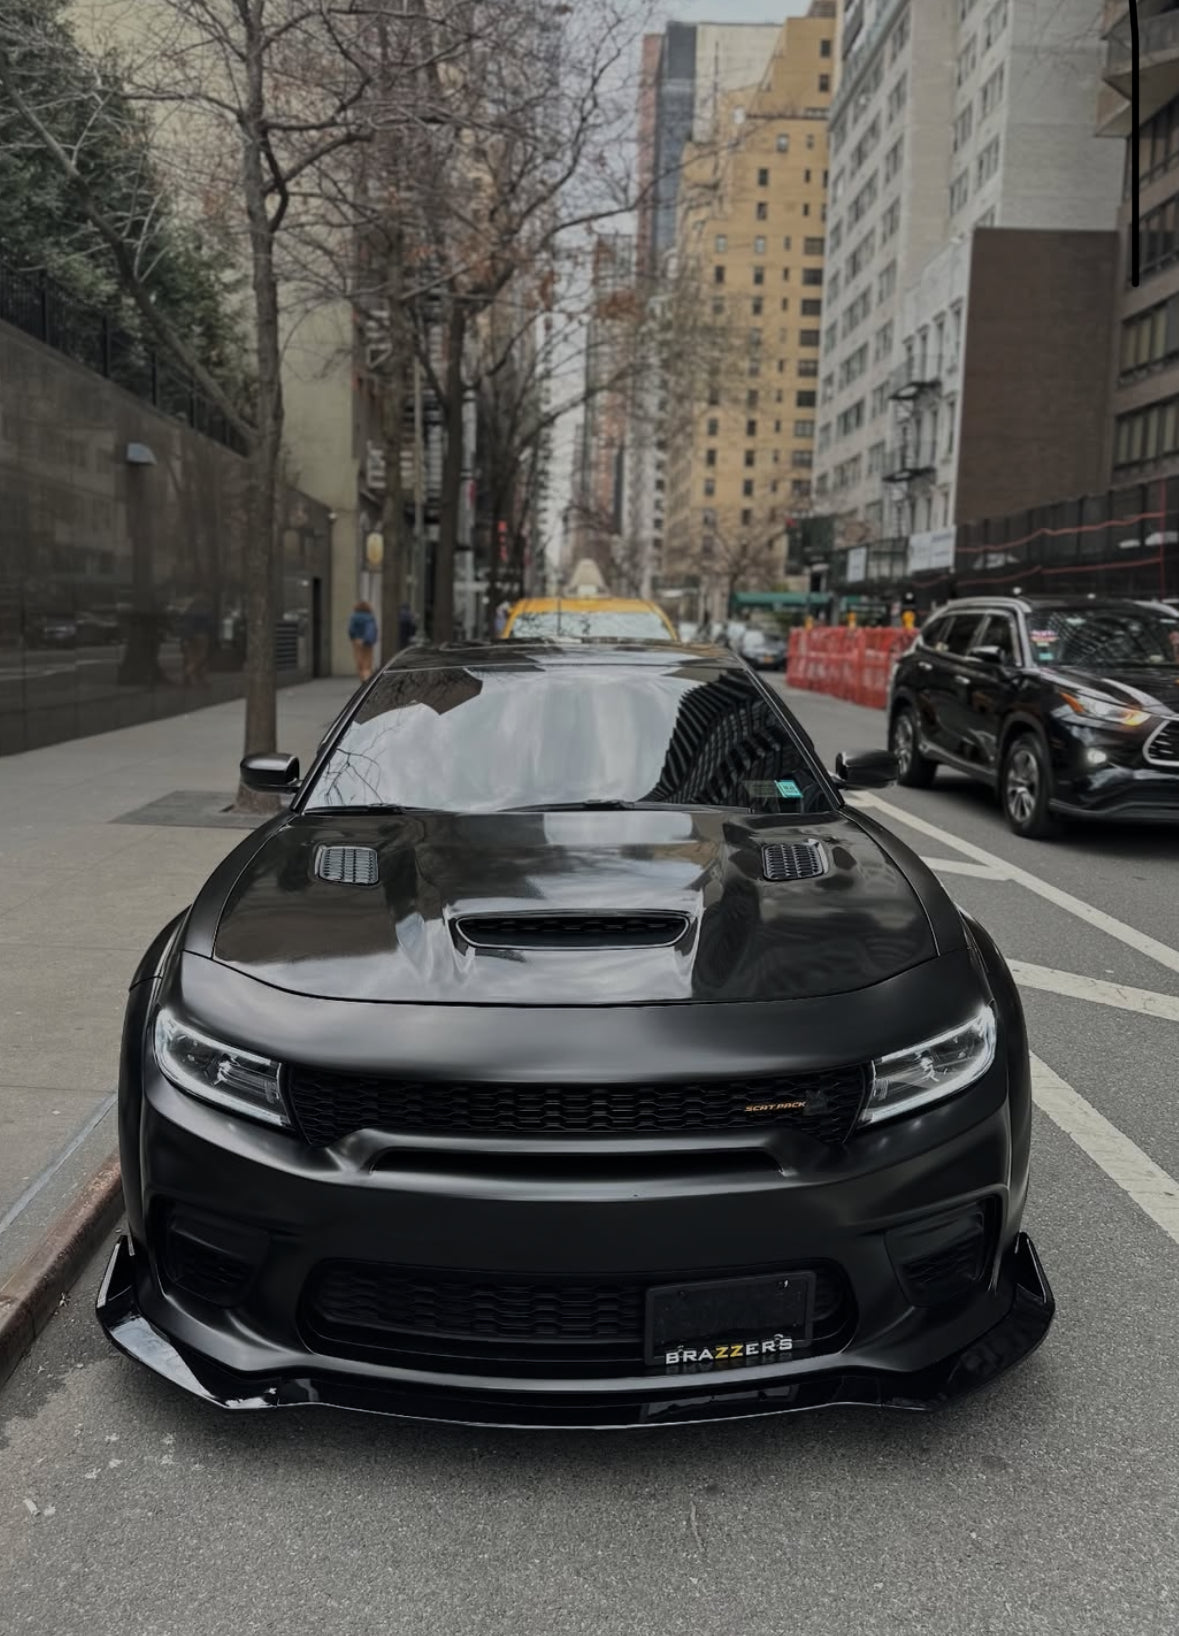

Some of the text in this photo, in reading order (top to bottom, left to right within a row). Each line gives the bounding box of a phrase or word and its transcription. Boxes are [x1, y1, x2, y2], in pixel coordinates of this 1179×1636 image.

[744, 1101, 807, 1112] SCAT PACK
[665, 1339, 793, 1364] BRAZZERS
